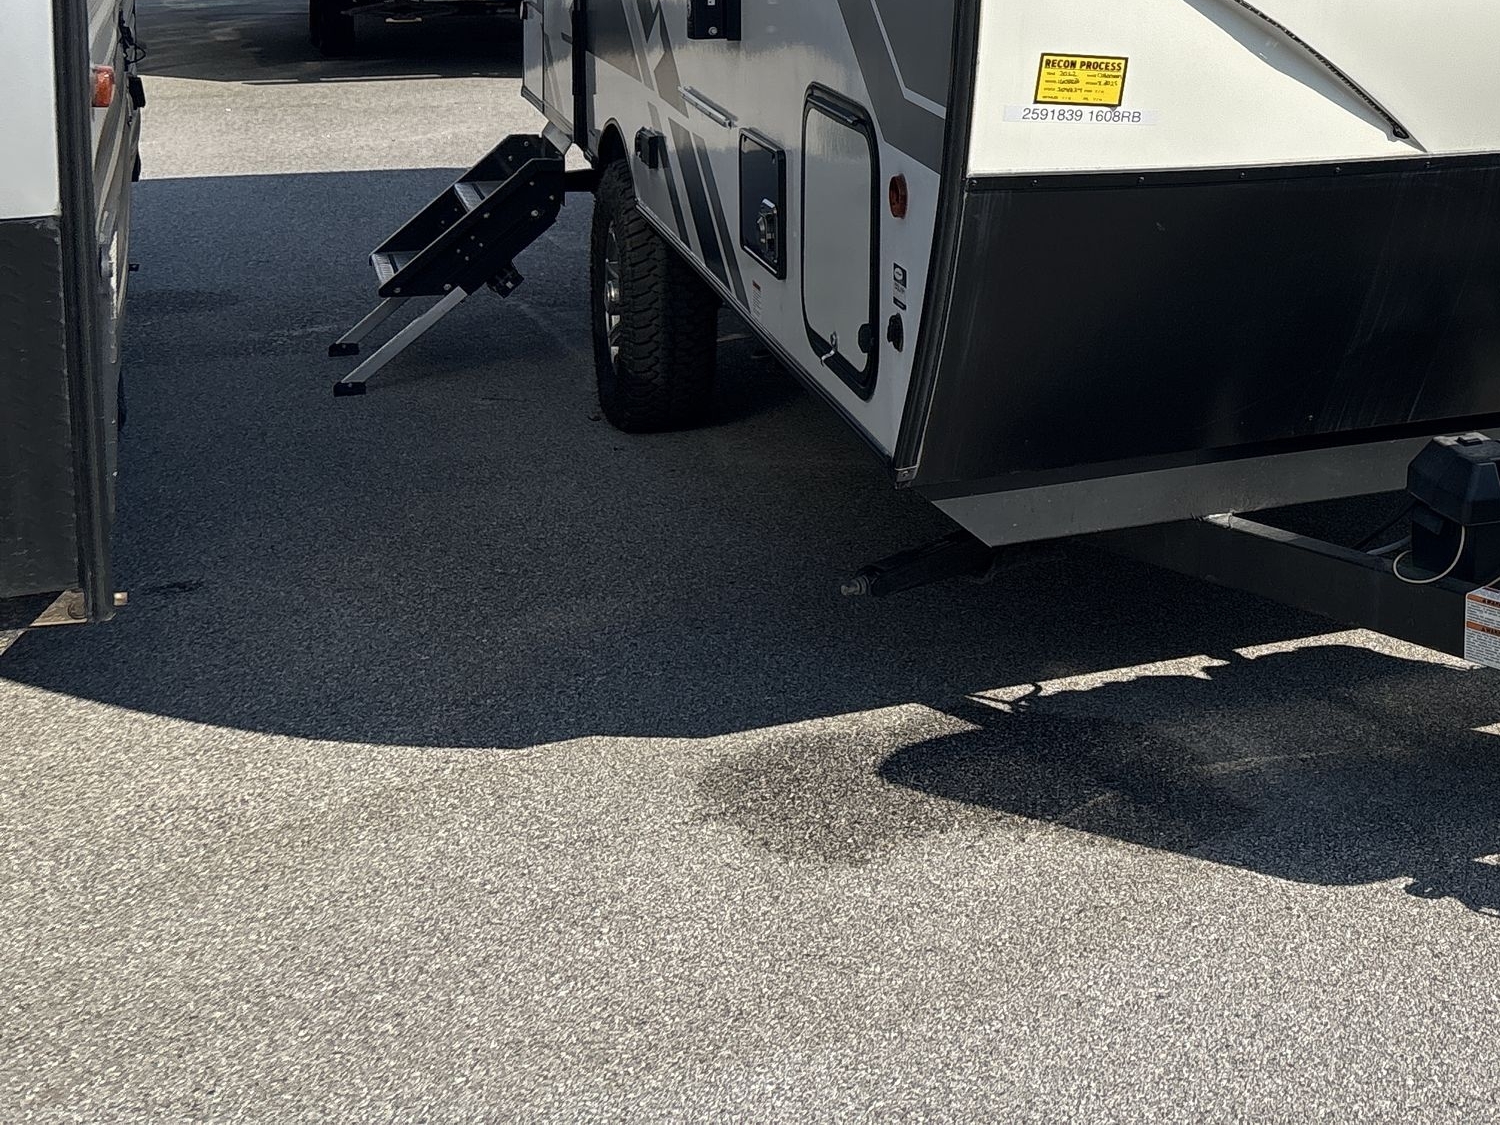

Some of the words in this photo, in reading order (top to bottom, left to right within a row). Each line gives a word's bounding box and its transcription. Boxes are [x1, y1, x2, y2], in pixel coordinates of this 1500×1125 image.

[1044, 58, 1077, 69] RECON
[1079, 60, 1122, 71] PROCESS
[1022, 107, 1083, 122] 2591839
[1089, 109, 1142, 123] 1608RB
